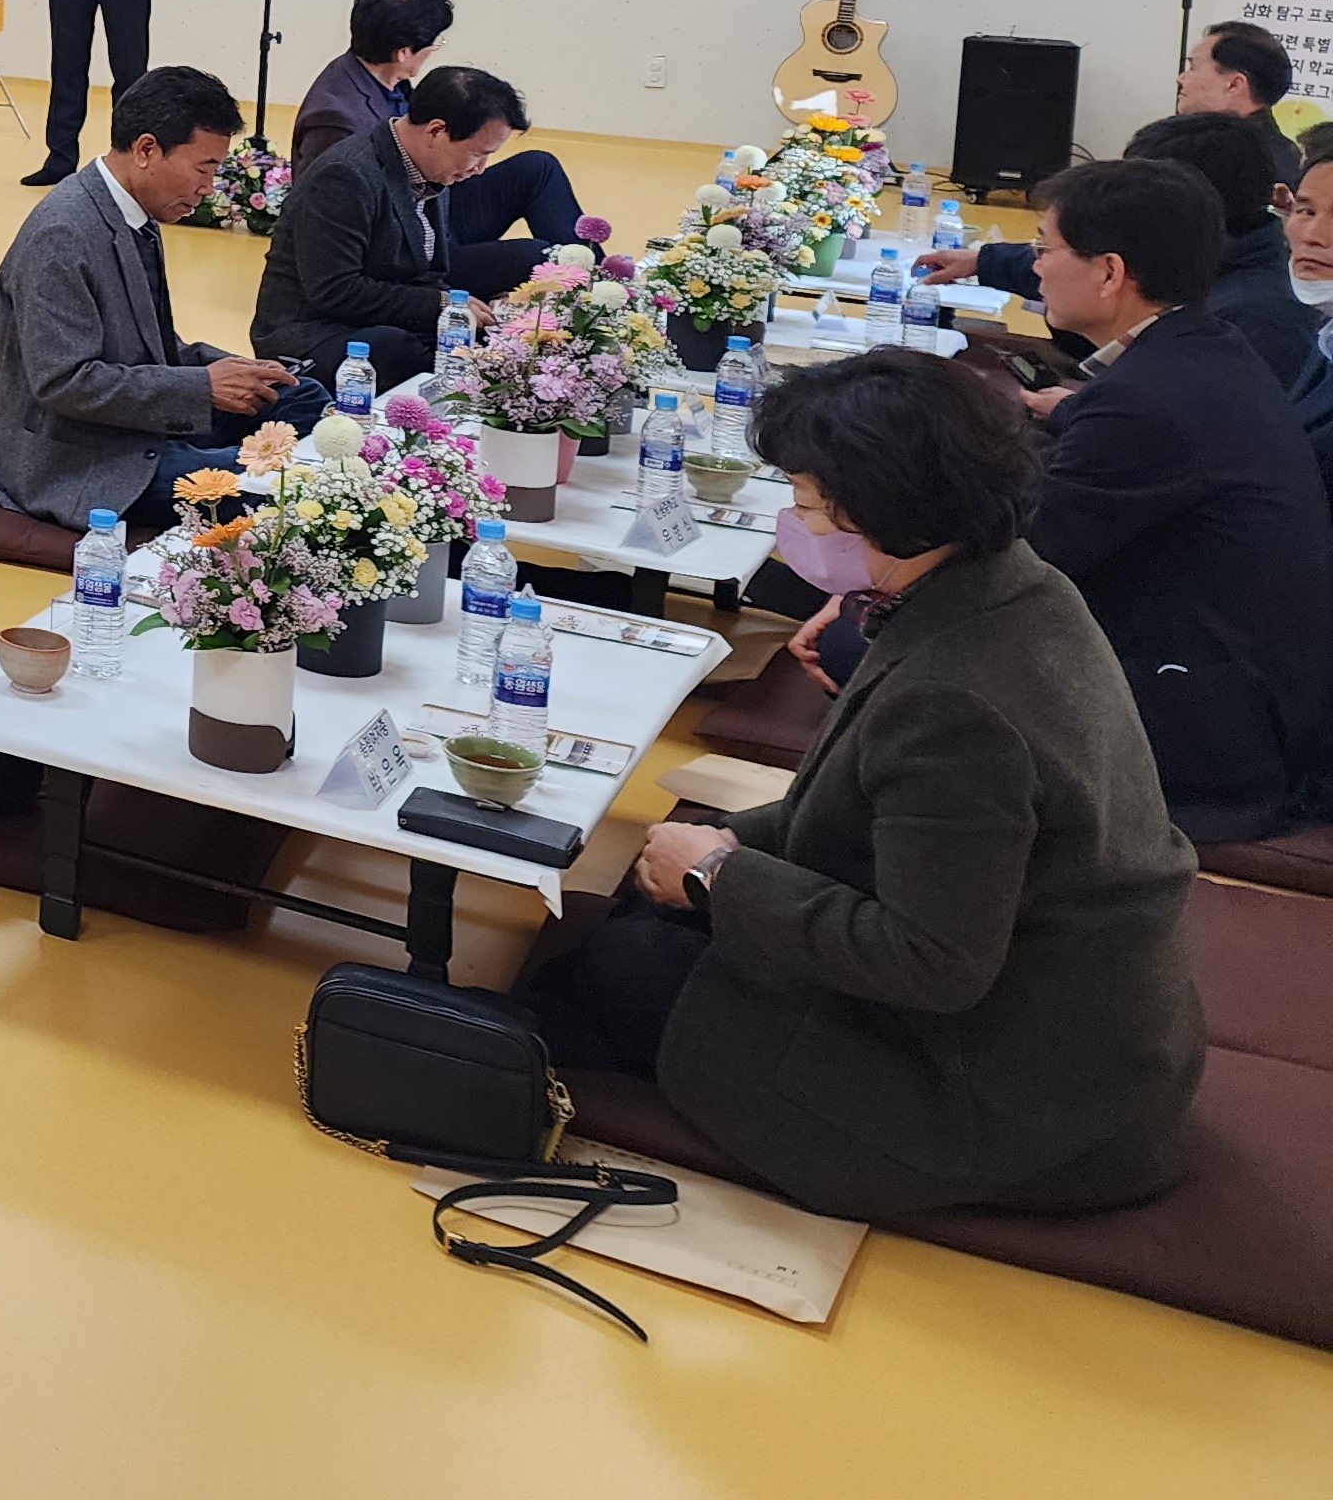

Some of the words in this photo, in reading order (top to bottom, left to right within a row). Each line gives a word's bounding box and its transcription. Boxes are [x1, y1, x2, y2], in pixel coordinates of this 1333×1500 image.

[1243, 2, 1273, 18] 심화
[1276, 6, 1304, 22] 탐구
[1302, 37, 1331, 53] 특별
[1287, 82, 1333, 99] 프로그
